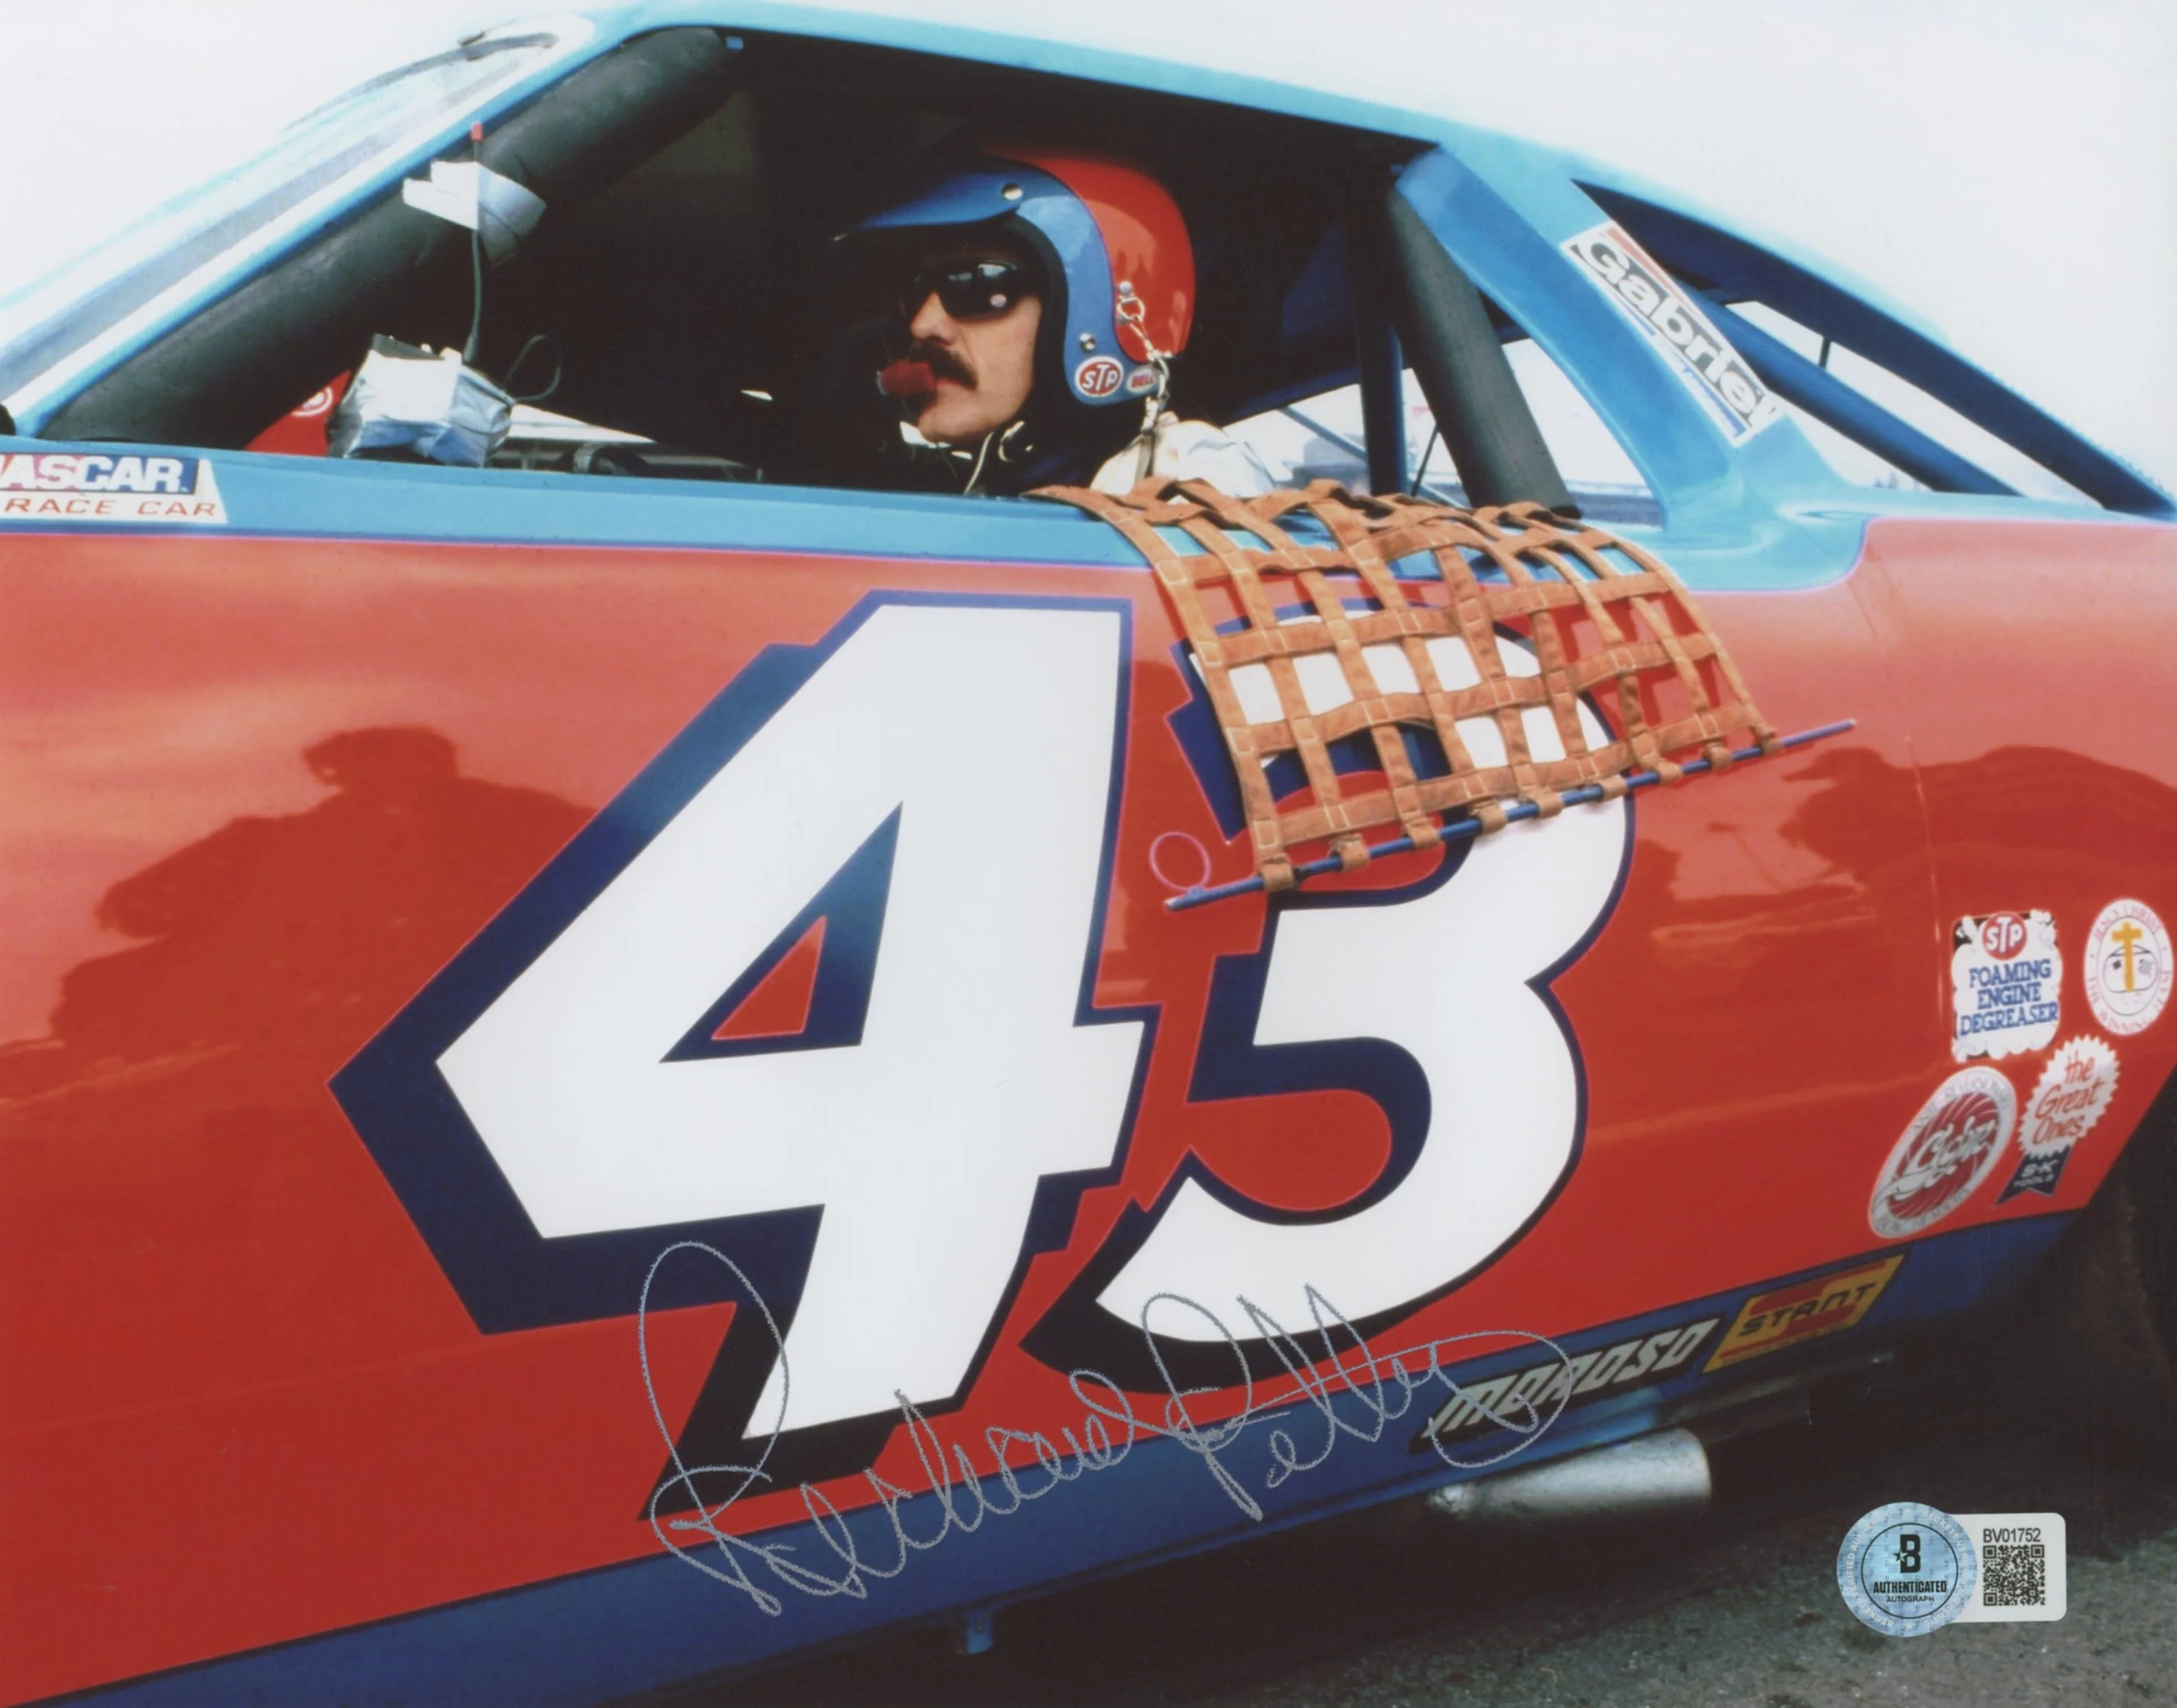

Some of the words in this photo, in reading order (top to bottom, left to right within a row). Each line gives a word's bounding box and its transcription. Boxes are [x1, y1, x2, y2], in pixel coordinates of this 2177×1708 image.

[1083, 363, 1119, 391] STP
[0, 454, 183, 492] ASCAR
[4, 497, 118, 515] RACE
[137, 500, 217, 517] CAR
[1985, 915, 2023, 953] STP
[1968, 958, 2051, 988] FOAMING
[1977, 981, 2042, 1010] ENGINE
[411, 601, 1632, 1447] 43
[1960, 1001, 2059, 1036] DEGREASER
[2065, 1049, 2095, 1085] the
[2035, 1076, 2105, 1119] Great
[2032, 1114, 2086, 1146] Ones
